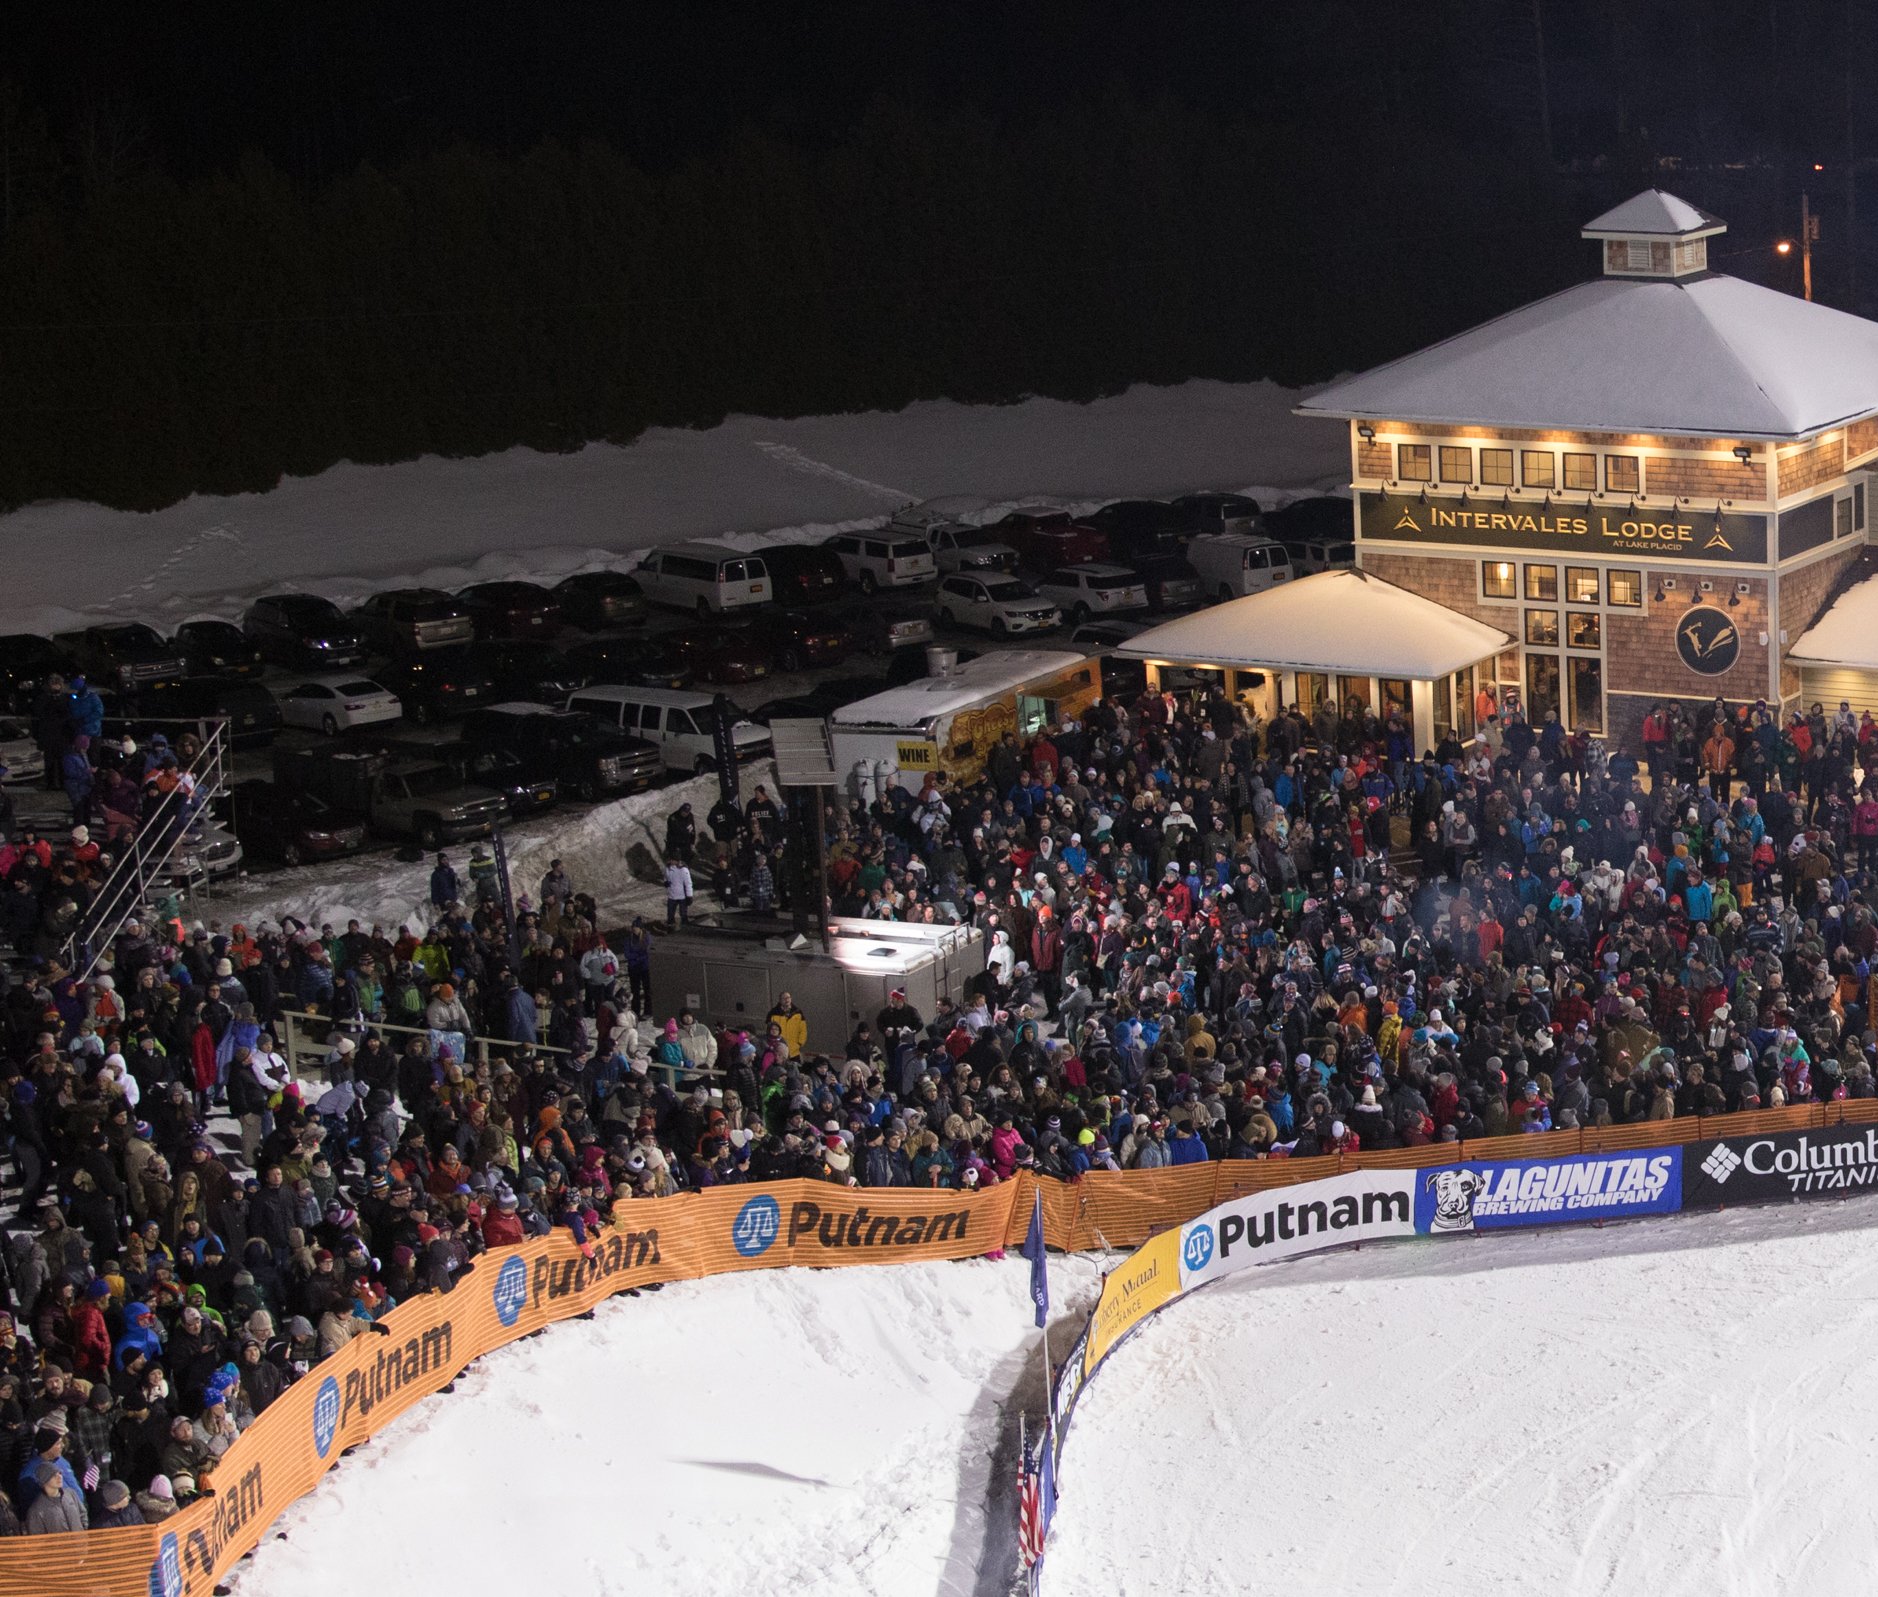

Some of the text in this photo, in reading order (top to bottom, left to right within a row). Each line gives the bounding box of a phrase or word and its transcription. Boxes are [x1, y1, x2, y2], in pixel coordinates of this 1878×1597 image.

[1430, 506, 1694, 542] INTERVALES LODGE
[1625, 541, 1649, 549] LAKE
[1650, 542, 1683, 551] PLACID
[898, 747, 931, 764] WINE
[1473, 1186, 1665, 1217] BREWING COMPANY
[1478, 1154, 1673, 1204] LAGUNITAS
[788, 1201, 971, 1249] Putnam
[1218, 1188, 1410, 1258] Putnam
[1122, 1258, 1158, 1303] Mutual
[340, 1320, 452, 1430] Putnam
